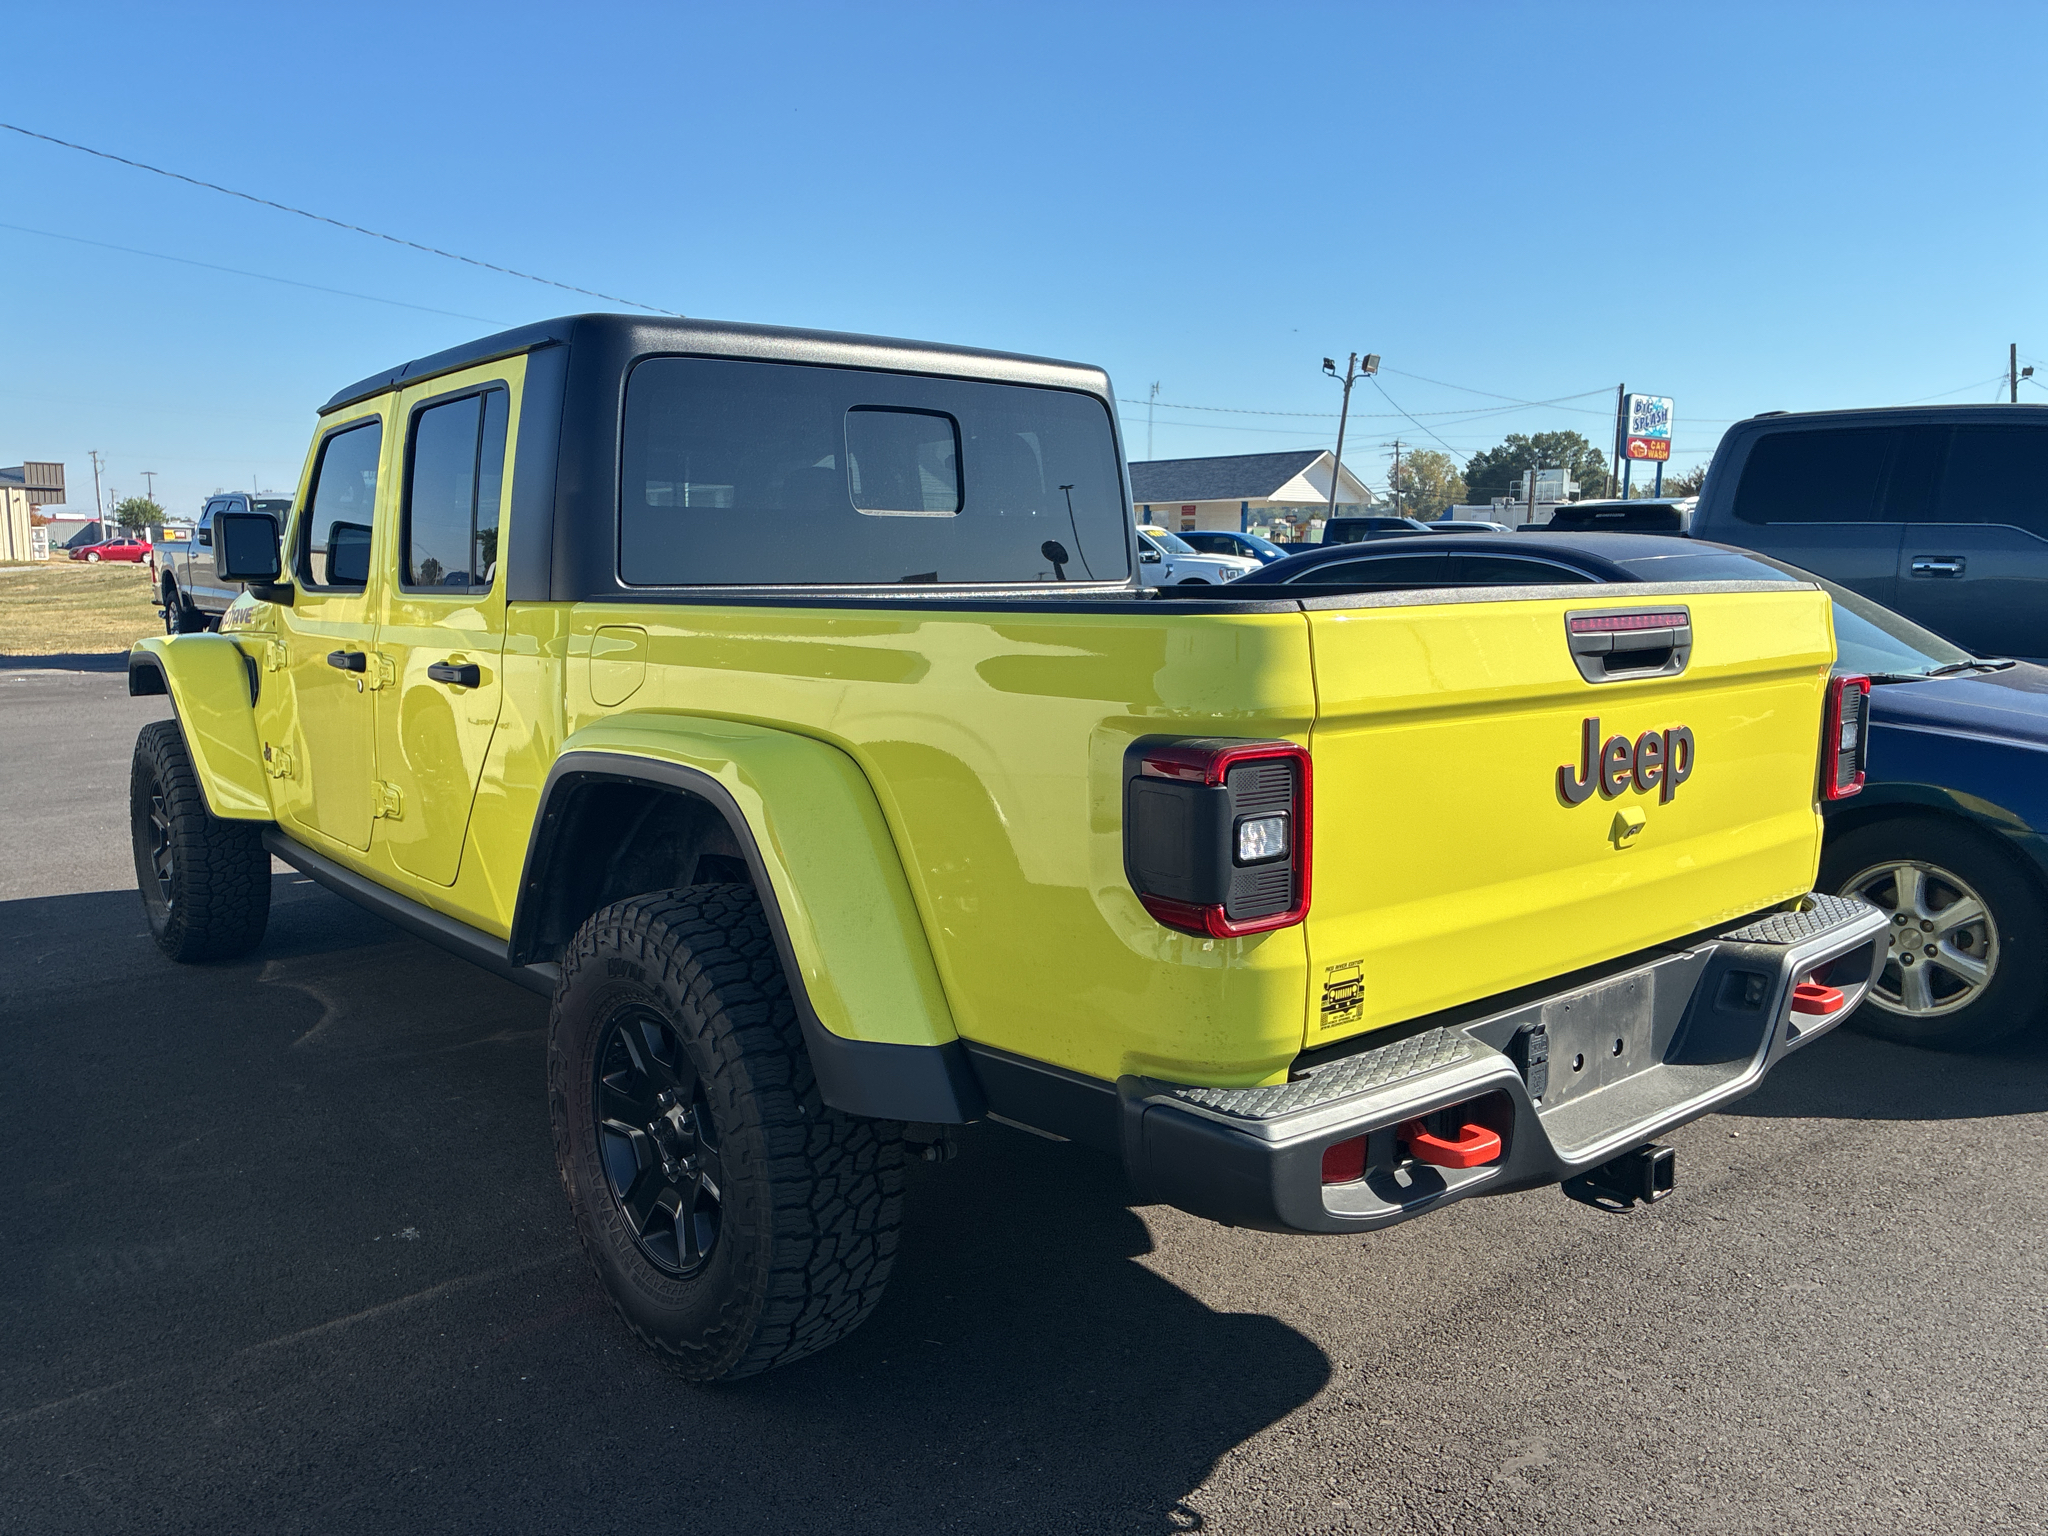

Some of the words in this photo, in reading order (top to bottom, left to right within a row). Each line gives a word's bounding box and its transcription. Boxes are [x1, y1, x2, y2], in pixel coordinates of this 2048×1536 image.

[1634, 400, 1653, 415] BIG
[1633, 408, 1668, 431] SPLASH
[1648, 449, 1668, 459] WASH
[1651, 441, 1666, 451] CAR
[221, 607, 253, 628] OJAVE
[1557, 715, 1695, 804] Jeep
